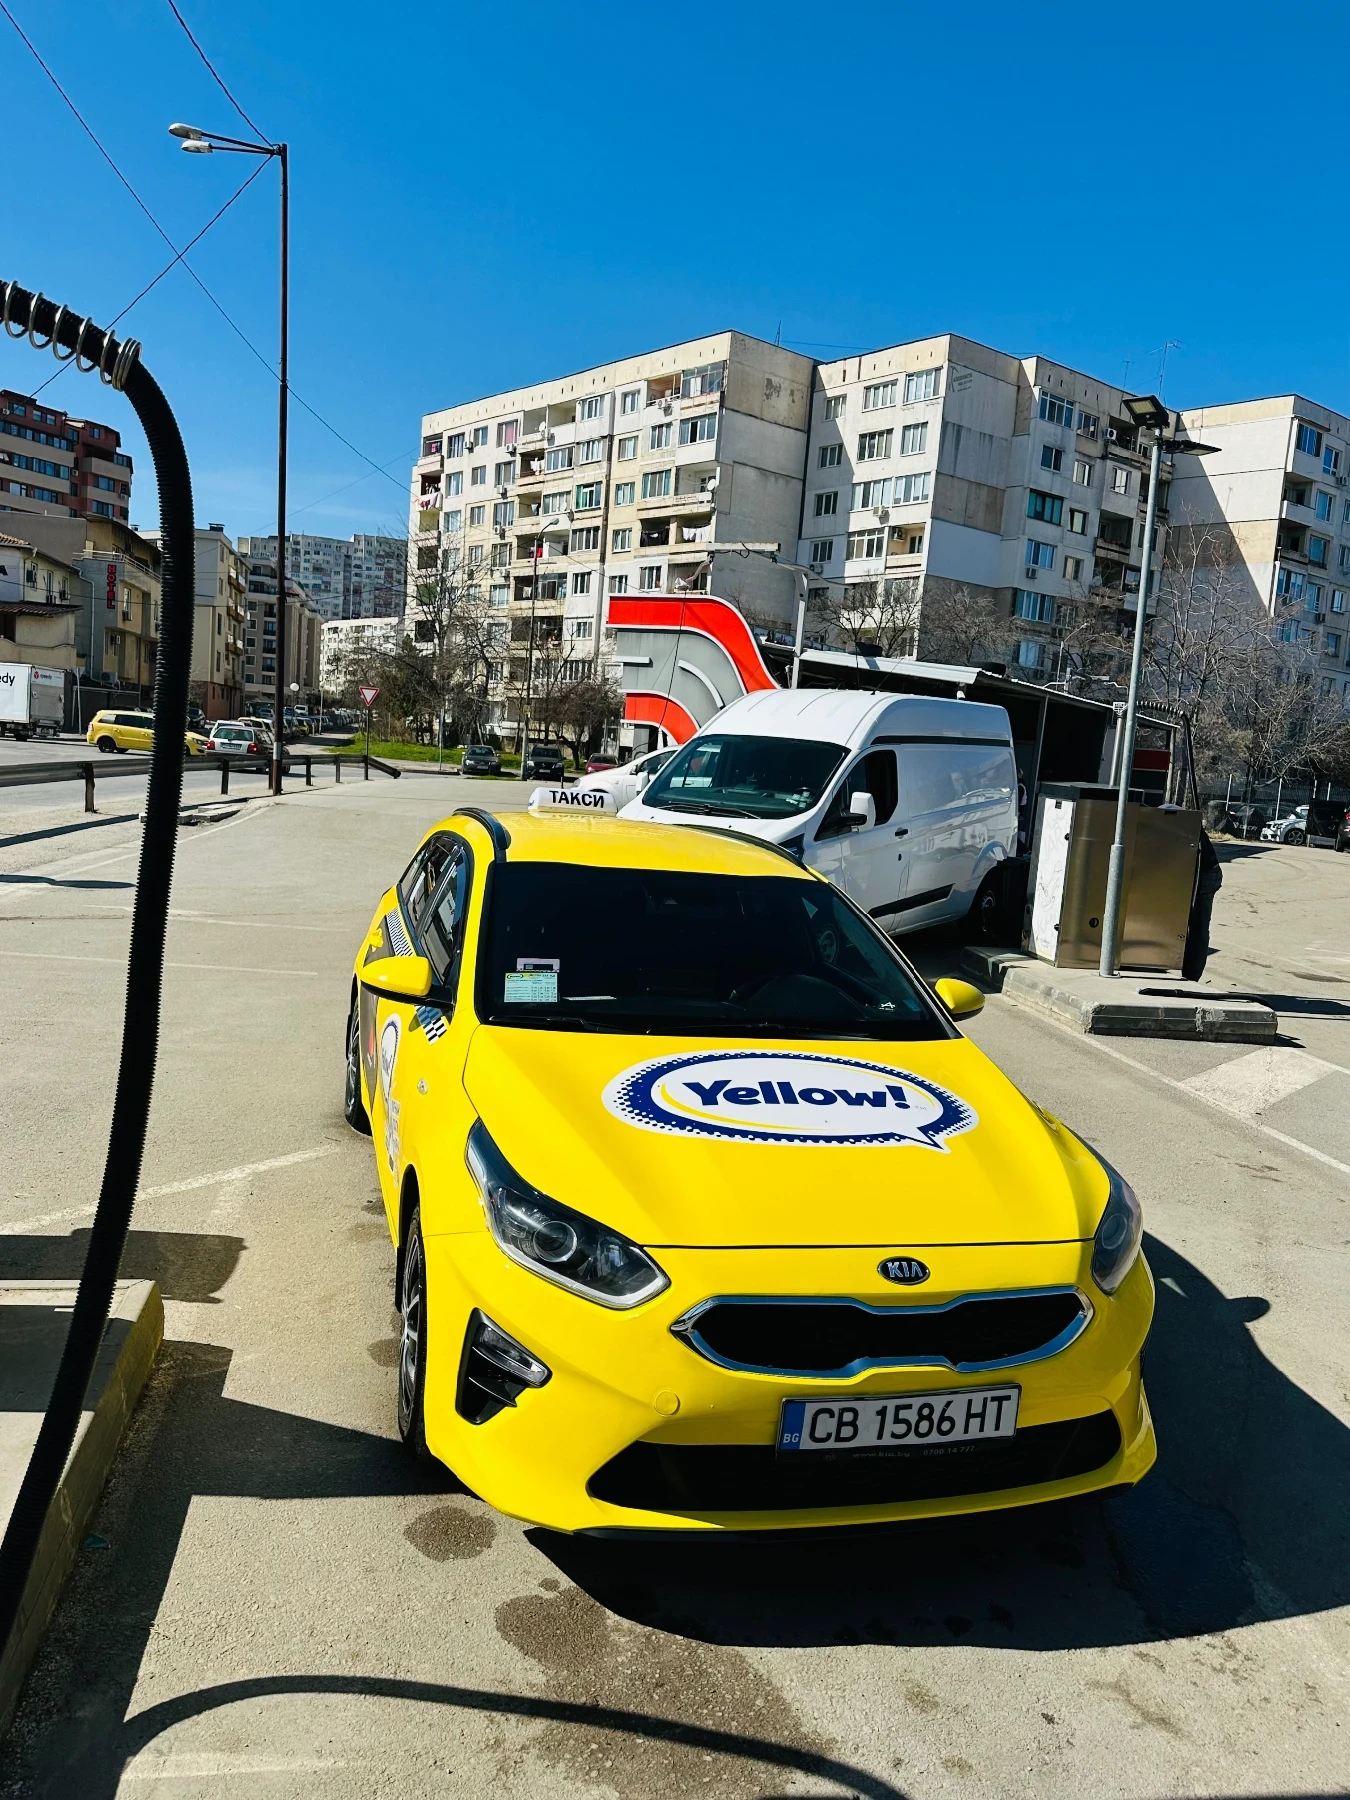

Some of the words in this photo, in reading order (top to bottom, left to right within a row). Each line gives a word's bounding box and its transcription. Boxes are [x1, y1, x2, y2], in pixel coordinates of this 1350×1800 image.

[107, 564, 116, 609] HOTEL
[0, 672, 15, 686] dy
[549, 790, 604, 808] ТАКСИ
[682, 1080, 911, 1109] Yellow!
[886, 1261, 923, 1278] KIA
[809, 1407, 859, 1443] CB
[875, 1400, 956, 1441] 1586
[963, 1395, 1012, 1434] HT
[783, 1433, 799, 1444] BG
